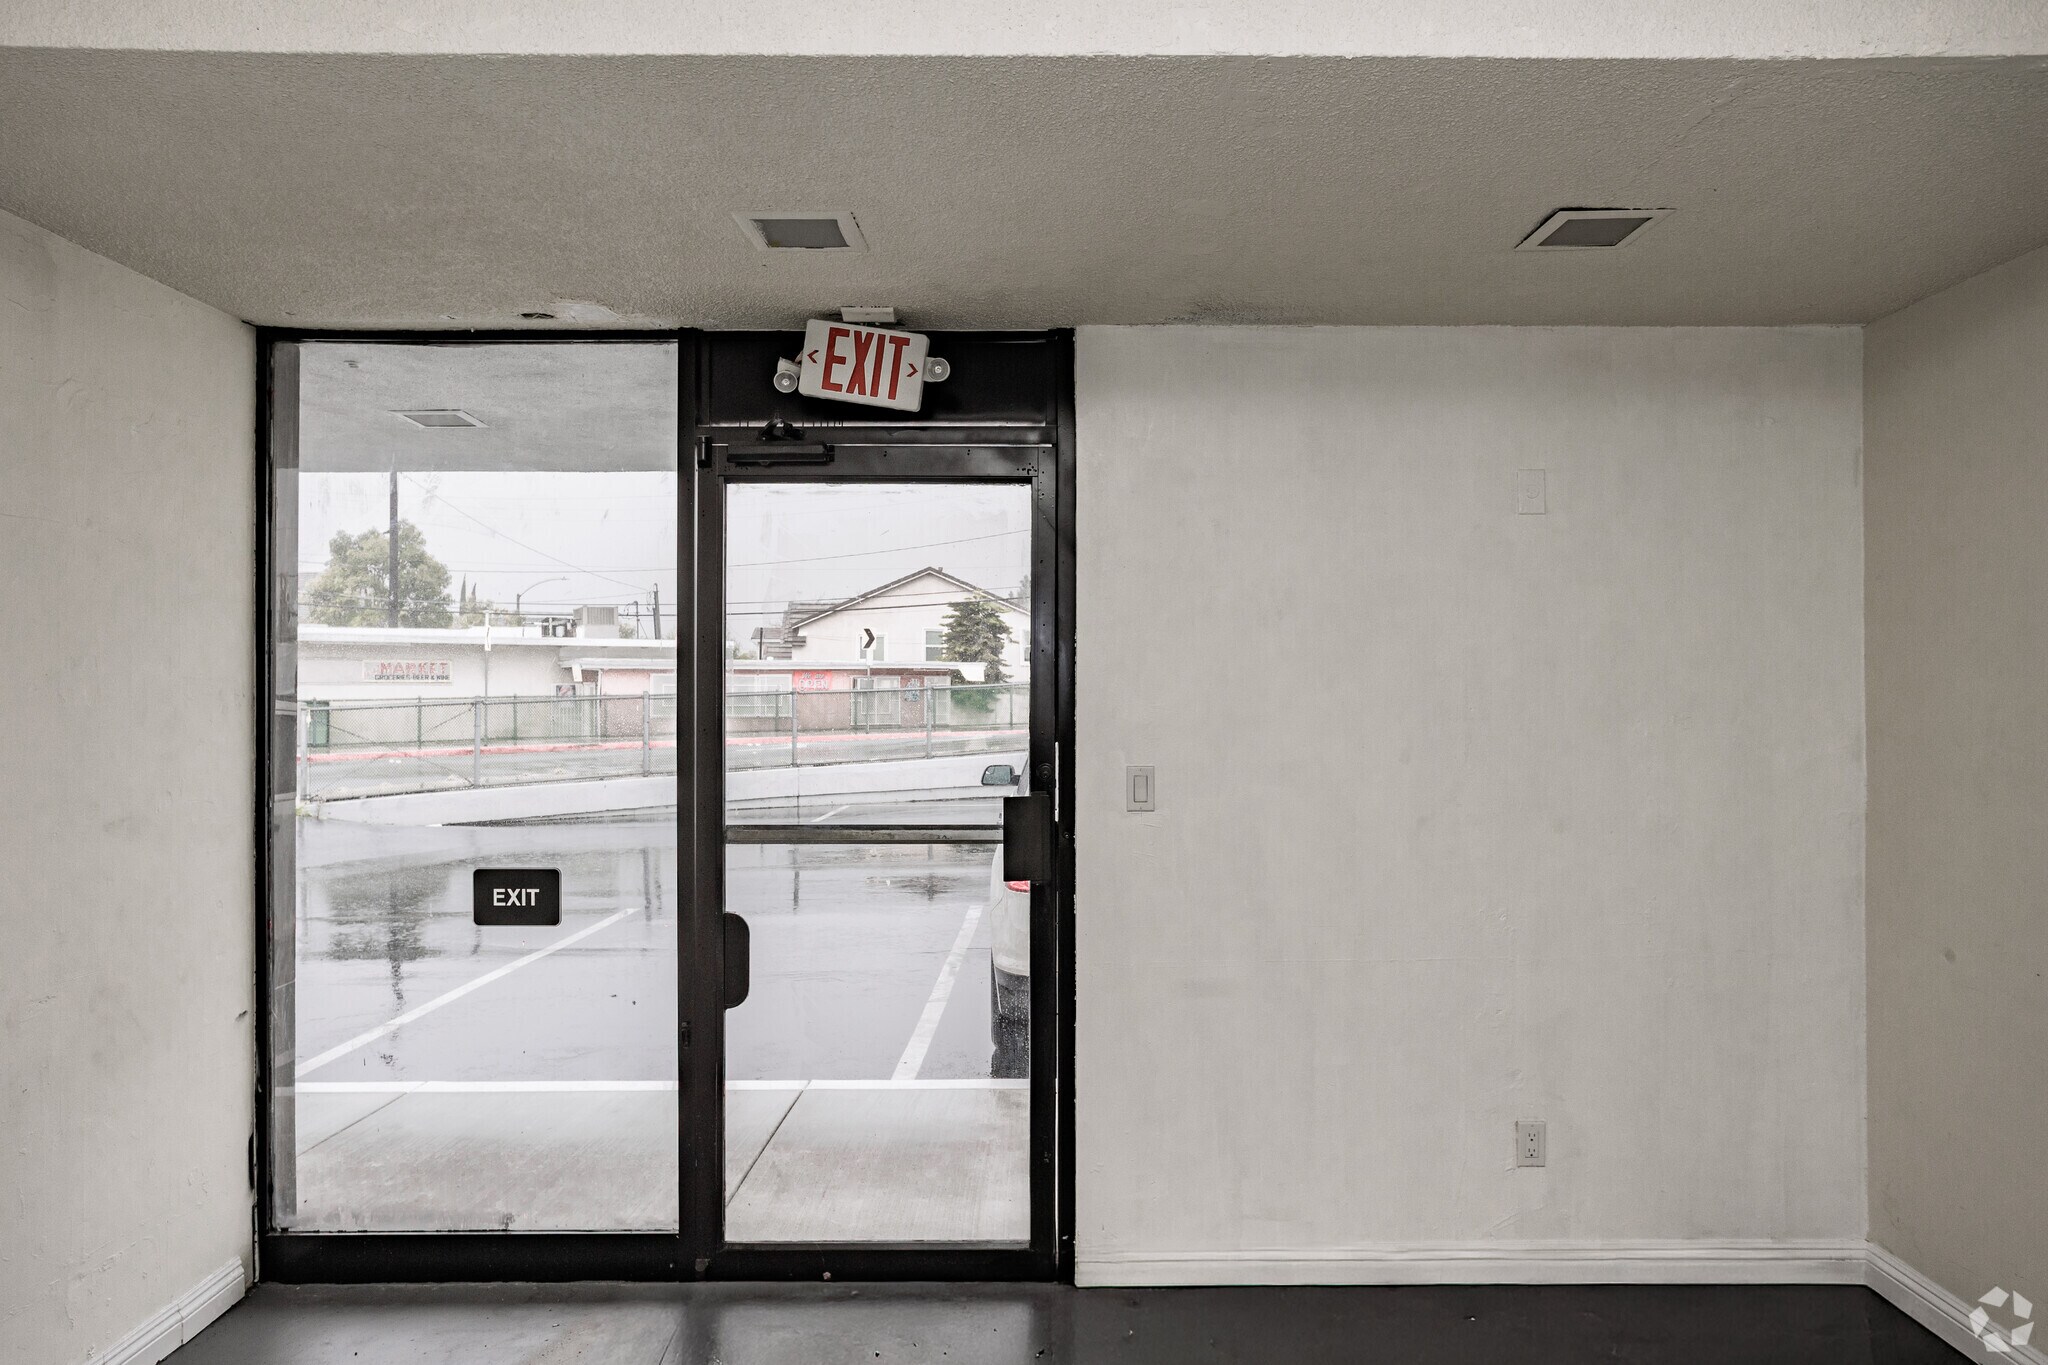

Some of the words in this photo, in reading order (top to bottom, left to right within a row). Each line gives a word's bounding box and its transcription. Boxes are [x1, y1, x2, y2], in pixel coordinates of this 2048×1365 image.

[821, 326, 911, 401] EXIT
[380, 662, 449, 675] MARKET
[798, 679, 828, 690] OPEN
[493, 888, 540, 906] EXIT
